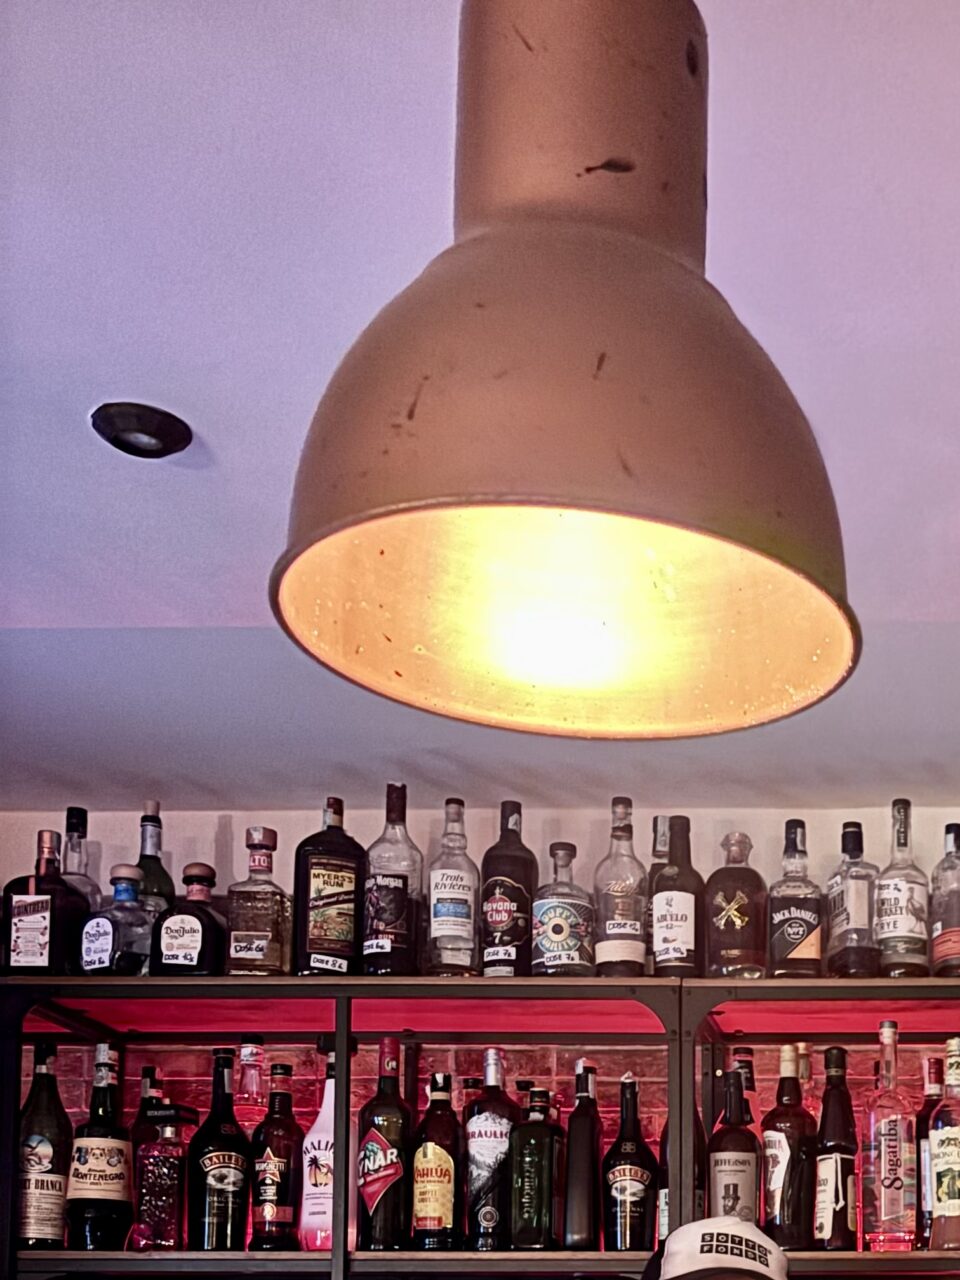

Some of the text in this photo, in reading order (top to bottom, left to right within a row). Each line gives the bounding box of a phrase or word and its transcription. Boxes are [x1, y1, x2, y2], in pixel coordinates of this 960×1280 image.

[322, 880, 344, 890] RUM
[440, 873, 464, 882] Trois
[487, 910, 508, 922] Club
[772, 909, 790, 924] JACK
[493, 932, 502, 944] 7
[542, 935, 576, 950] WHITE
[880, 1116, 905, 1191] Sagatiba
[72, 1168, 126, 1182] MONTENEGRO
[607, 1167, 649, 1184] BAILEYS
[702, 1233, 768, 1257] SOTTO
[701, 1245, 768, 1267] FONDO
